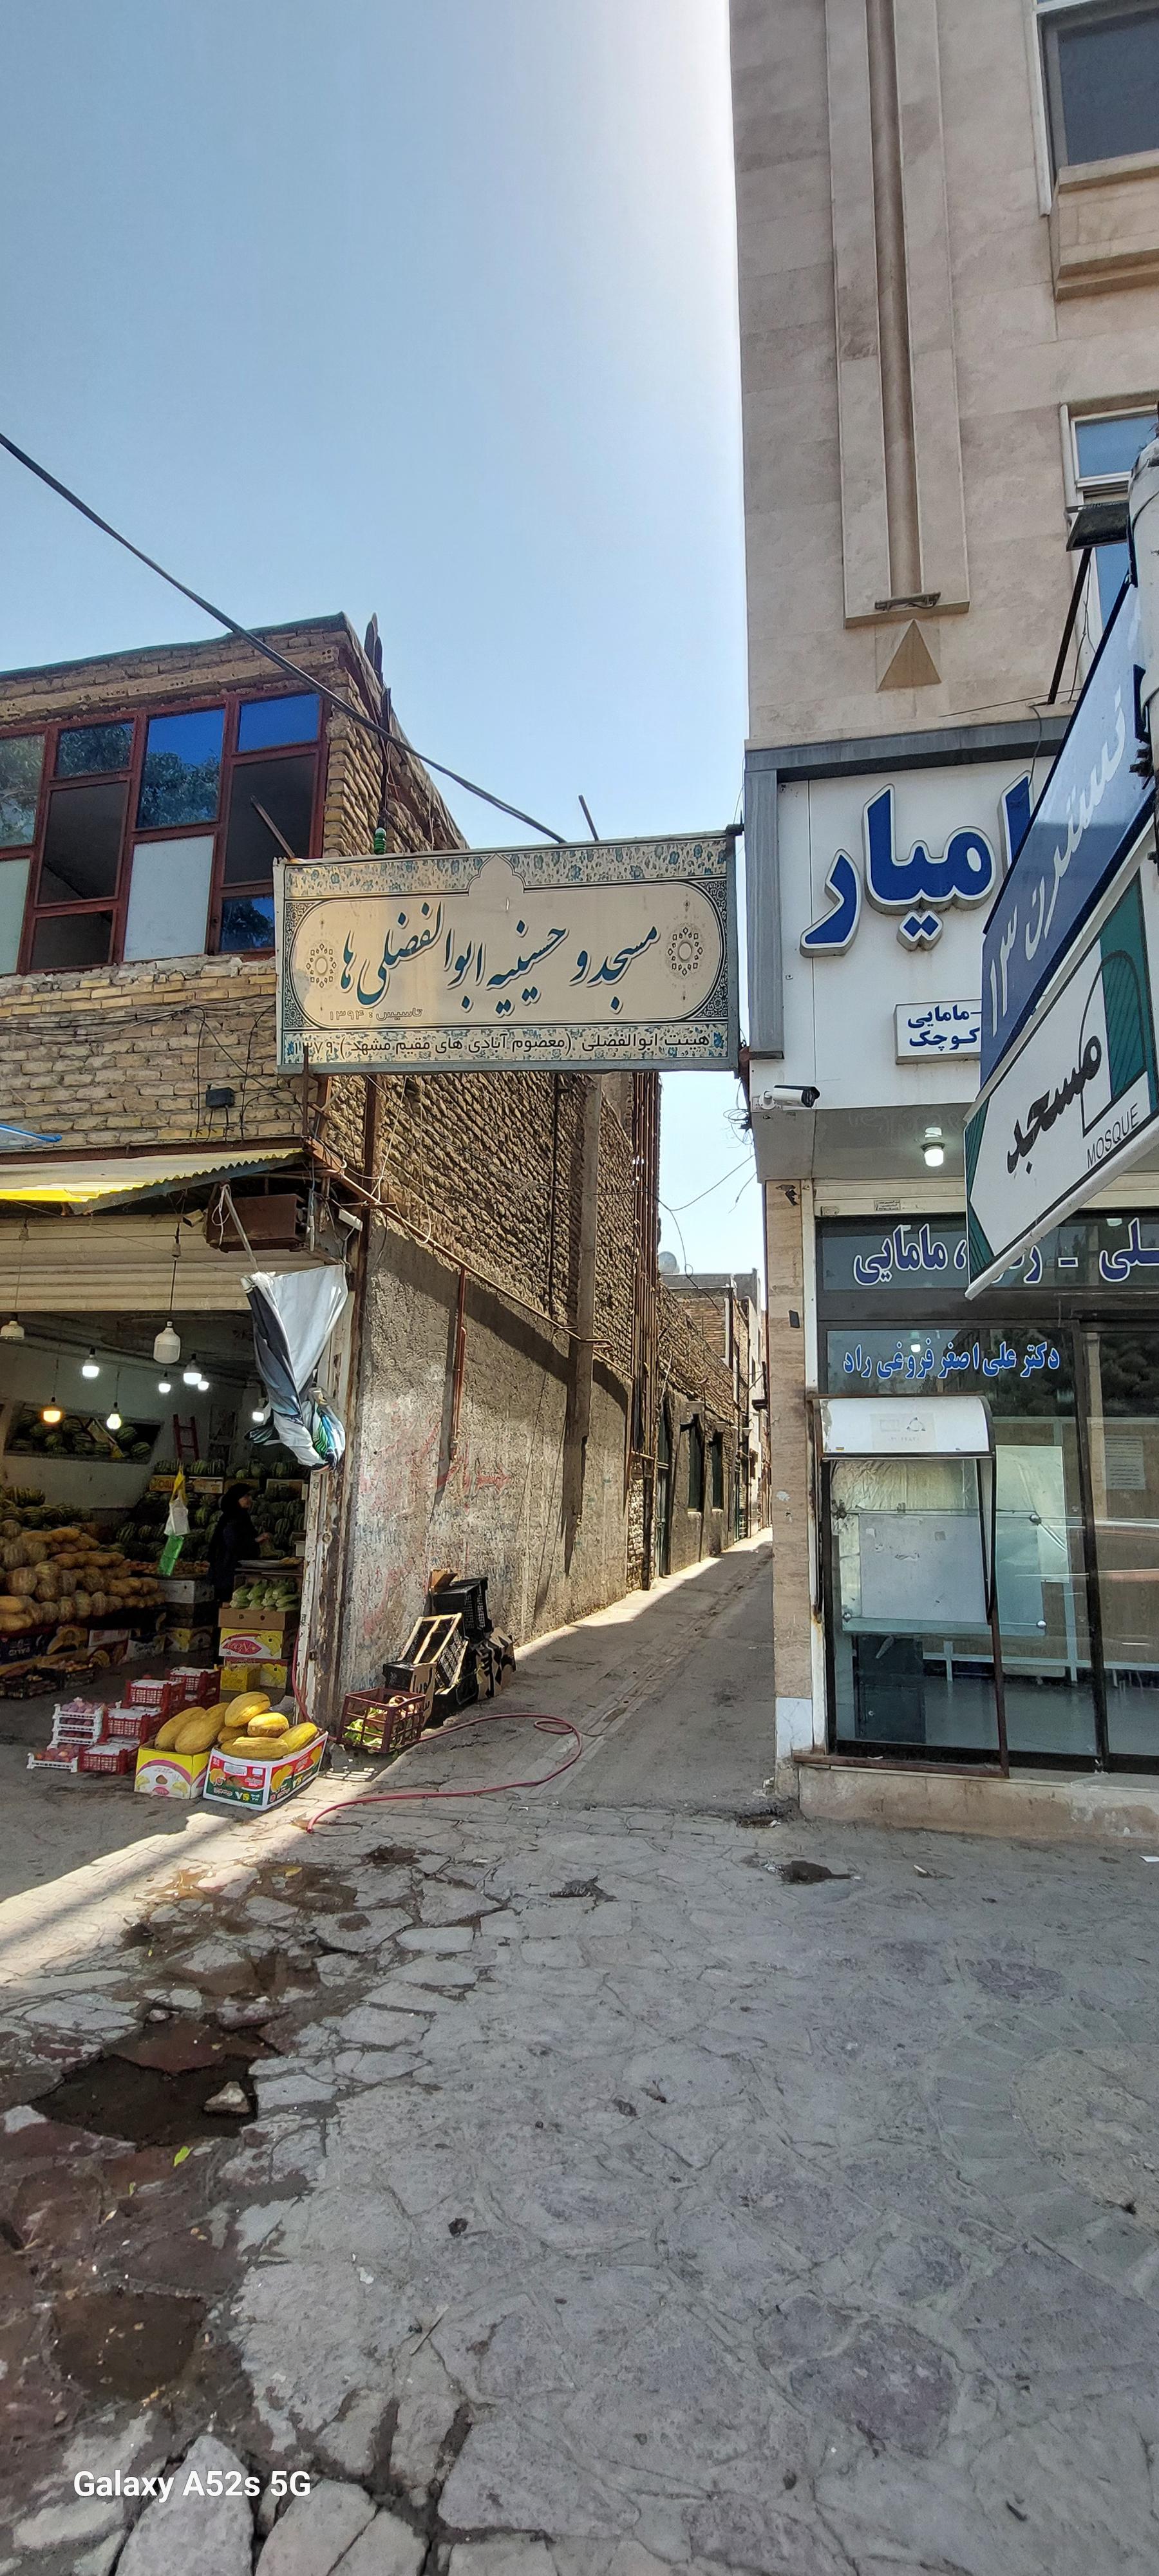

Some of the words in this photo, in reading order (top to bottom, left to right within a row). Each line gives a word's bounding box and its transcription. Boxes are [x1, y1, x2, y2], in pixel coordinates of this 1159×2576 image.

[1024, 683, 1126, 961] نسترن
[341, 929, 357, 993] ها
[357, 901, 485, 1012] ابوالفضلی
[486, 919, 570, 1017] حسینیه
[569, 950, 592, 987] و
[587, 925, 660, 1015] مسجد
[990, 904, 1018, 1038] ۱۳
[330, 1010, 365, 1021] ۱۳۹۴
[376, 1007, 423, 1021] تاسیس
[395, 1037, 430, 1055] مقیم
[435, 1037, 463, 1054] های
[468, 1033, 508, 1053] آبادی
[581, 1033, 658, 1052] ابوالفضلی
[664, 1034, 710, 1050] هیئت
[909, 1027, 981, 1052] کوچک
[1007, 1035, 1102, 1175] مسجد
[1086, 1102, 1139, 1170] MOSQUE
[853, 1223, 948, 1286] مامایی
[843, 1343, 872, 1378] راد
[876, 1336, 935, 1379] فروغی
[938, 1341, 979, 1379] اصغر
[982, 1341, 1017, 1377] علی
[1020, 1341, 1060, 1378] دکتر
